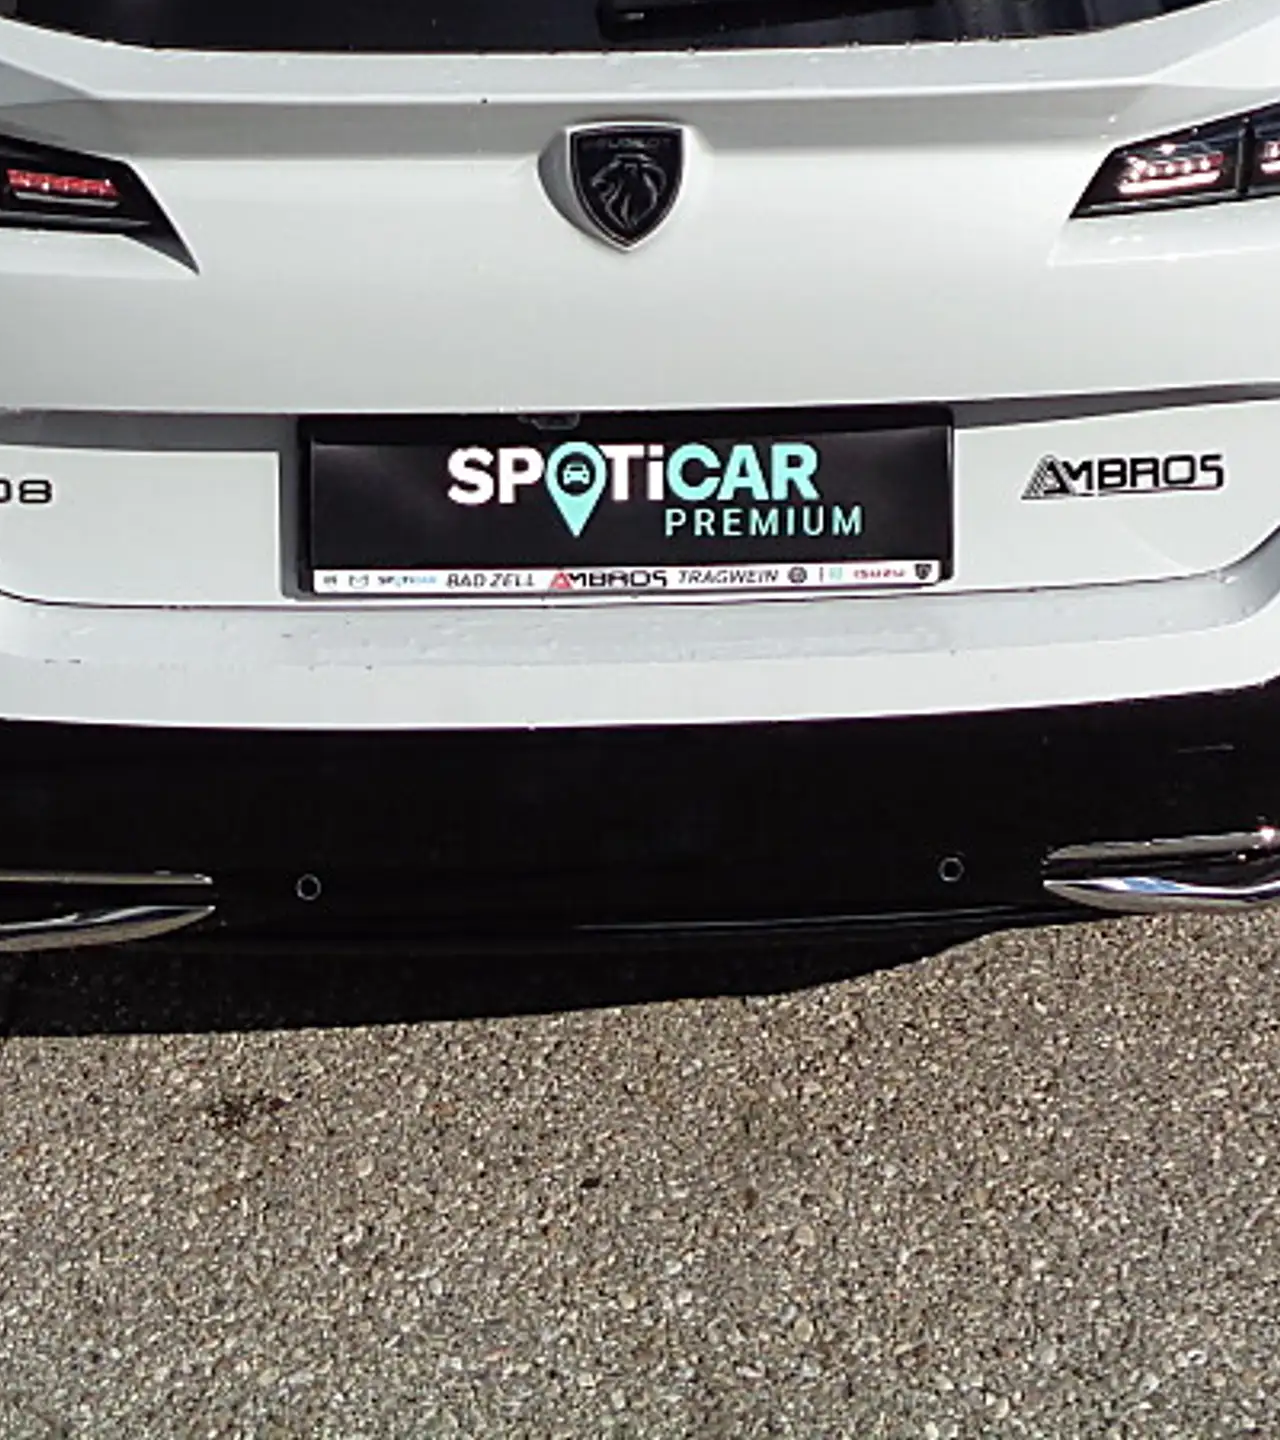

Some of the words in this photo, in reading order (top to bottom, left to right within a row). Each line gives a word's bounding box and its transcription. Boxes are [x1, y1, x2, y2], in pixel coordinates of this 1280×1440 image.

[1020, 454, 1224, 500] AMBROS
[665, 505, 863, 536] PREMIUM
[446, 573, 487, 588] BAD
[489, 573, 535, 588] ZELL
[549, 571, 668, 588] AMBROS
[678, 568, 778, 585] TRAGWEIN
